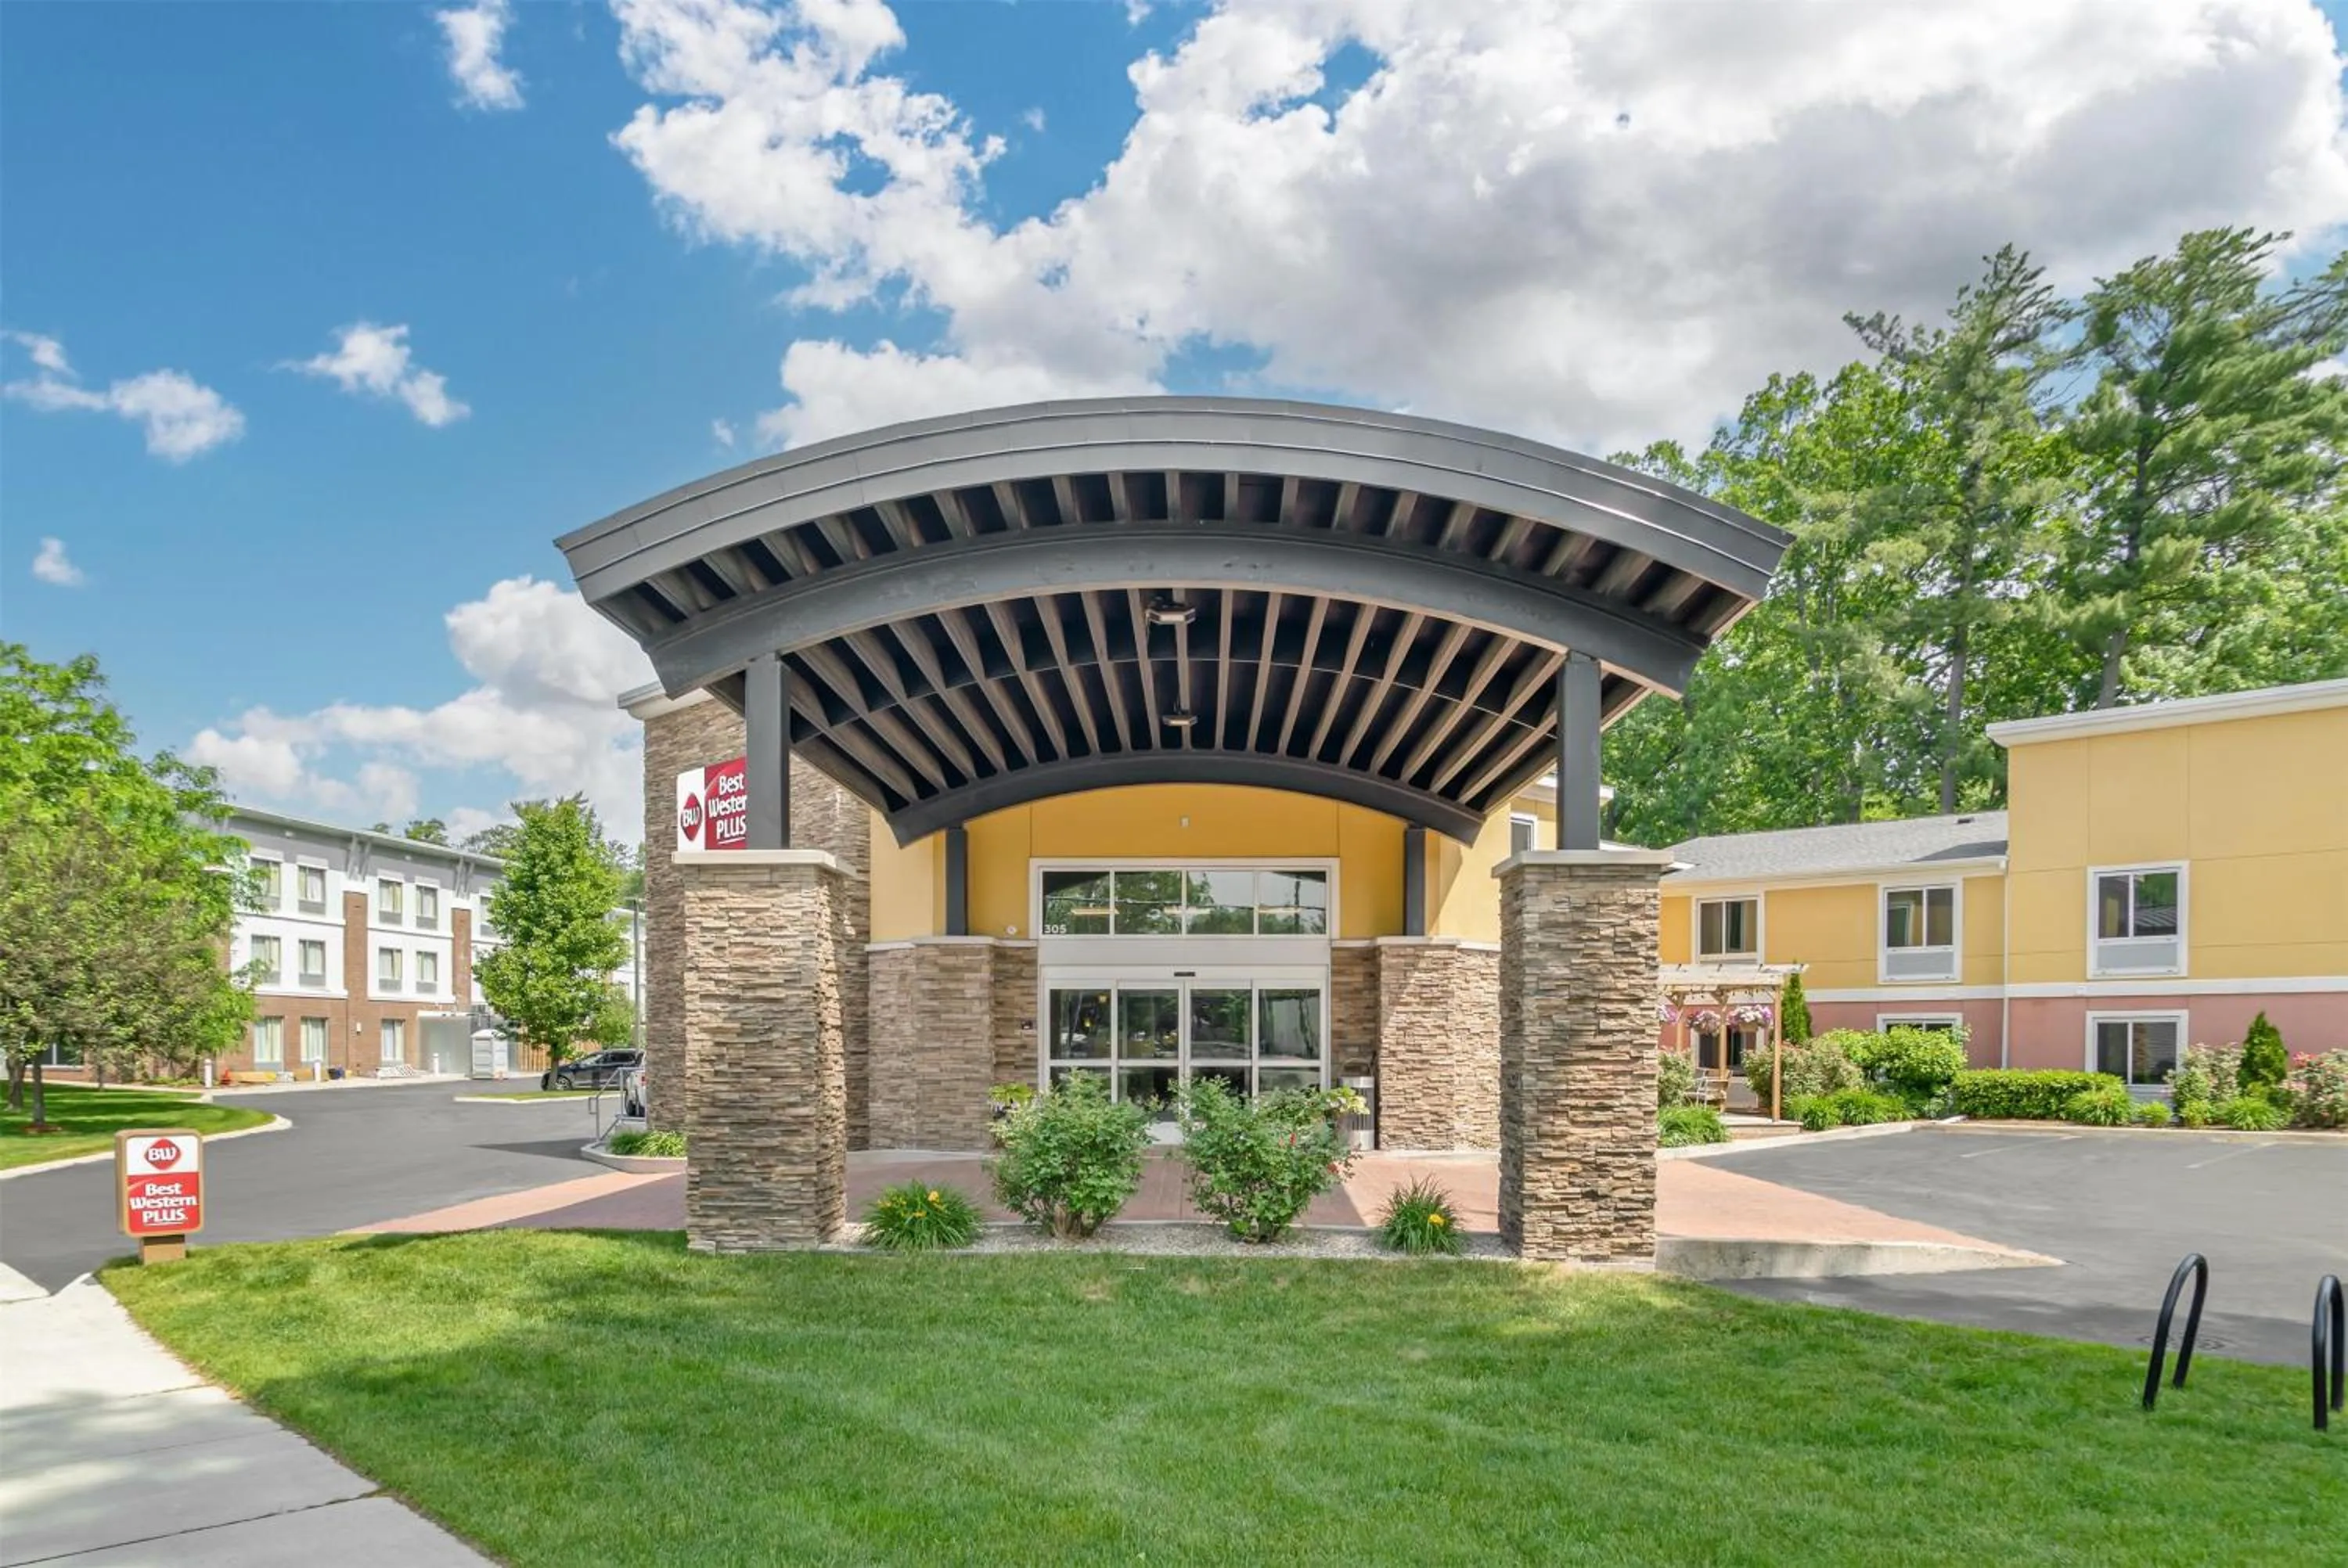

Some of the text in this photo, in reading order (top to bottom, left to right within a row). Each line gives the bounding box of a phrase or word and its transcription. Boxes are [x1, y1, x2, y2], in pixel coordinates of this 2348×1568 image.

[719, 773, 744, 795] Best
[708, 795, 747, 818] Wester
[682, 808, 700, 826] BW
[716, 815, 746, 840] PLUS
[1043, 925, 1067, 933] 305
[148, 1148, 176, 1161] BW
[145, 1183, 182, 1196] Best
[130, 1196, 196, 1210] Western
[142, 1208, 186, 1222] PLUS
